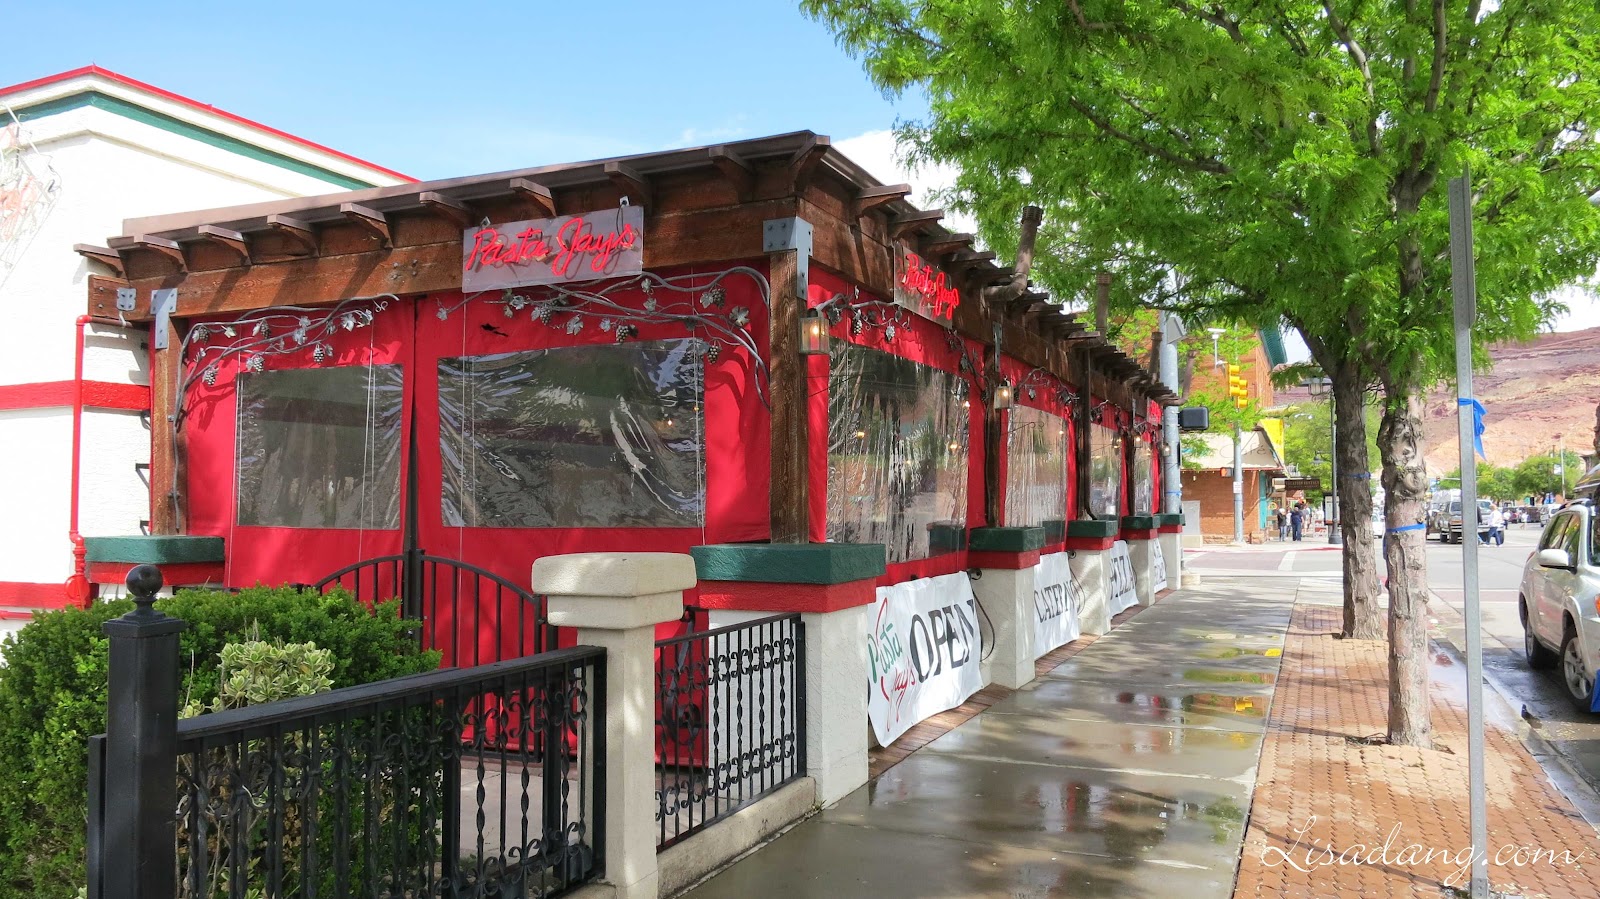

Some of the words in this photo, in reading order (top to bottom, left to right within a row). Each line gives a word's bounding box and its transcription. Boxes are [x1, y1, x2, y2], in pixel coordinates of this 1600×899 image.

[465, 227, 549, 271] Pasta
[867, 623, 903, 684] Pasta
[909, 598, 976, 684] OPEN
